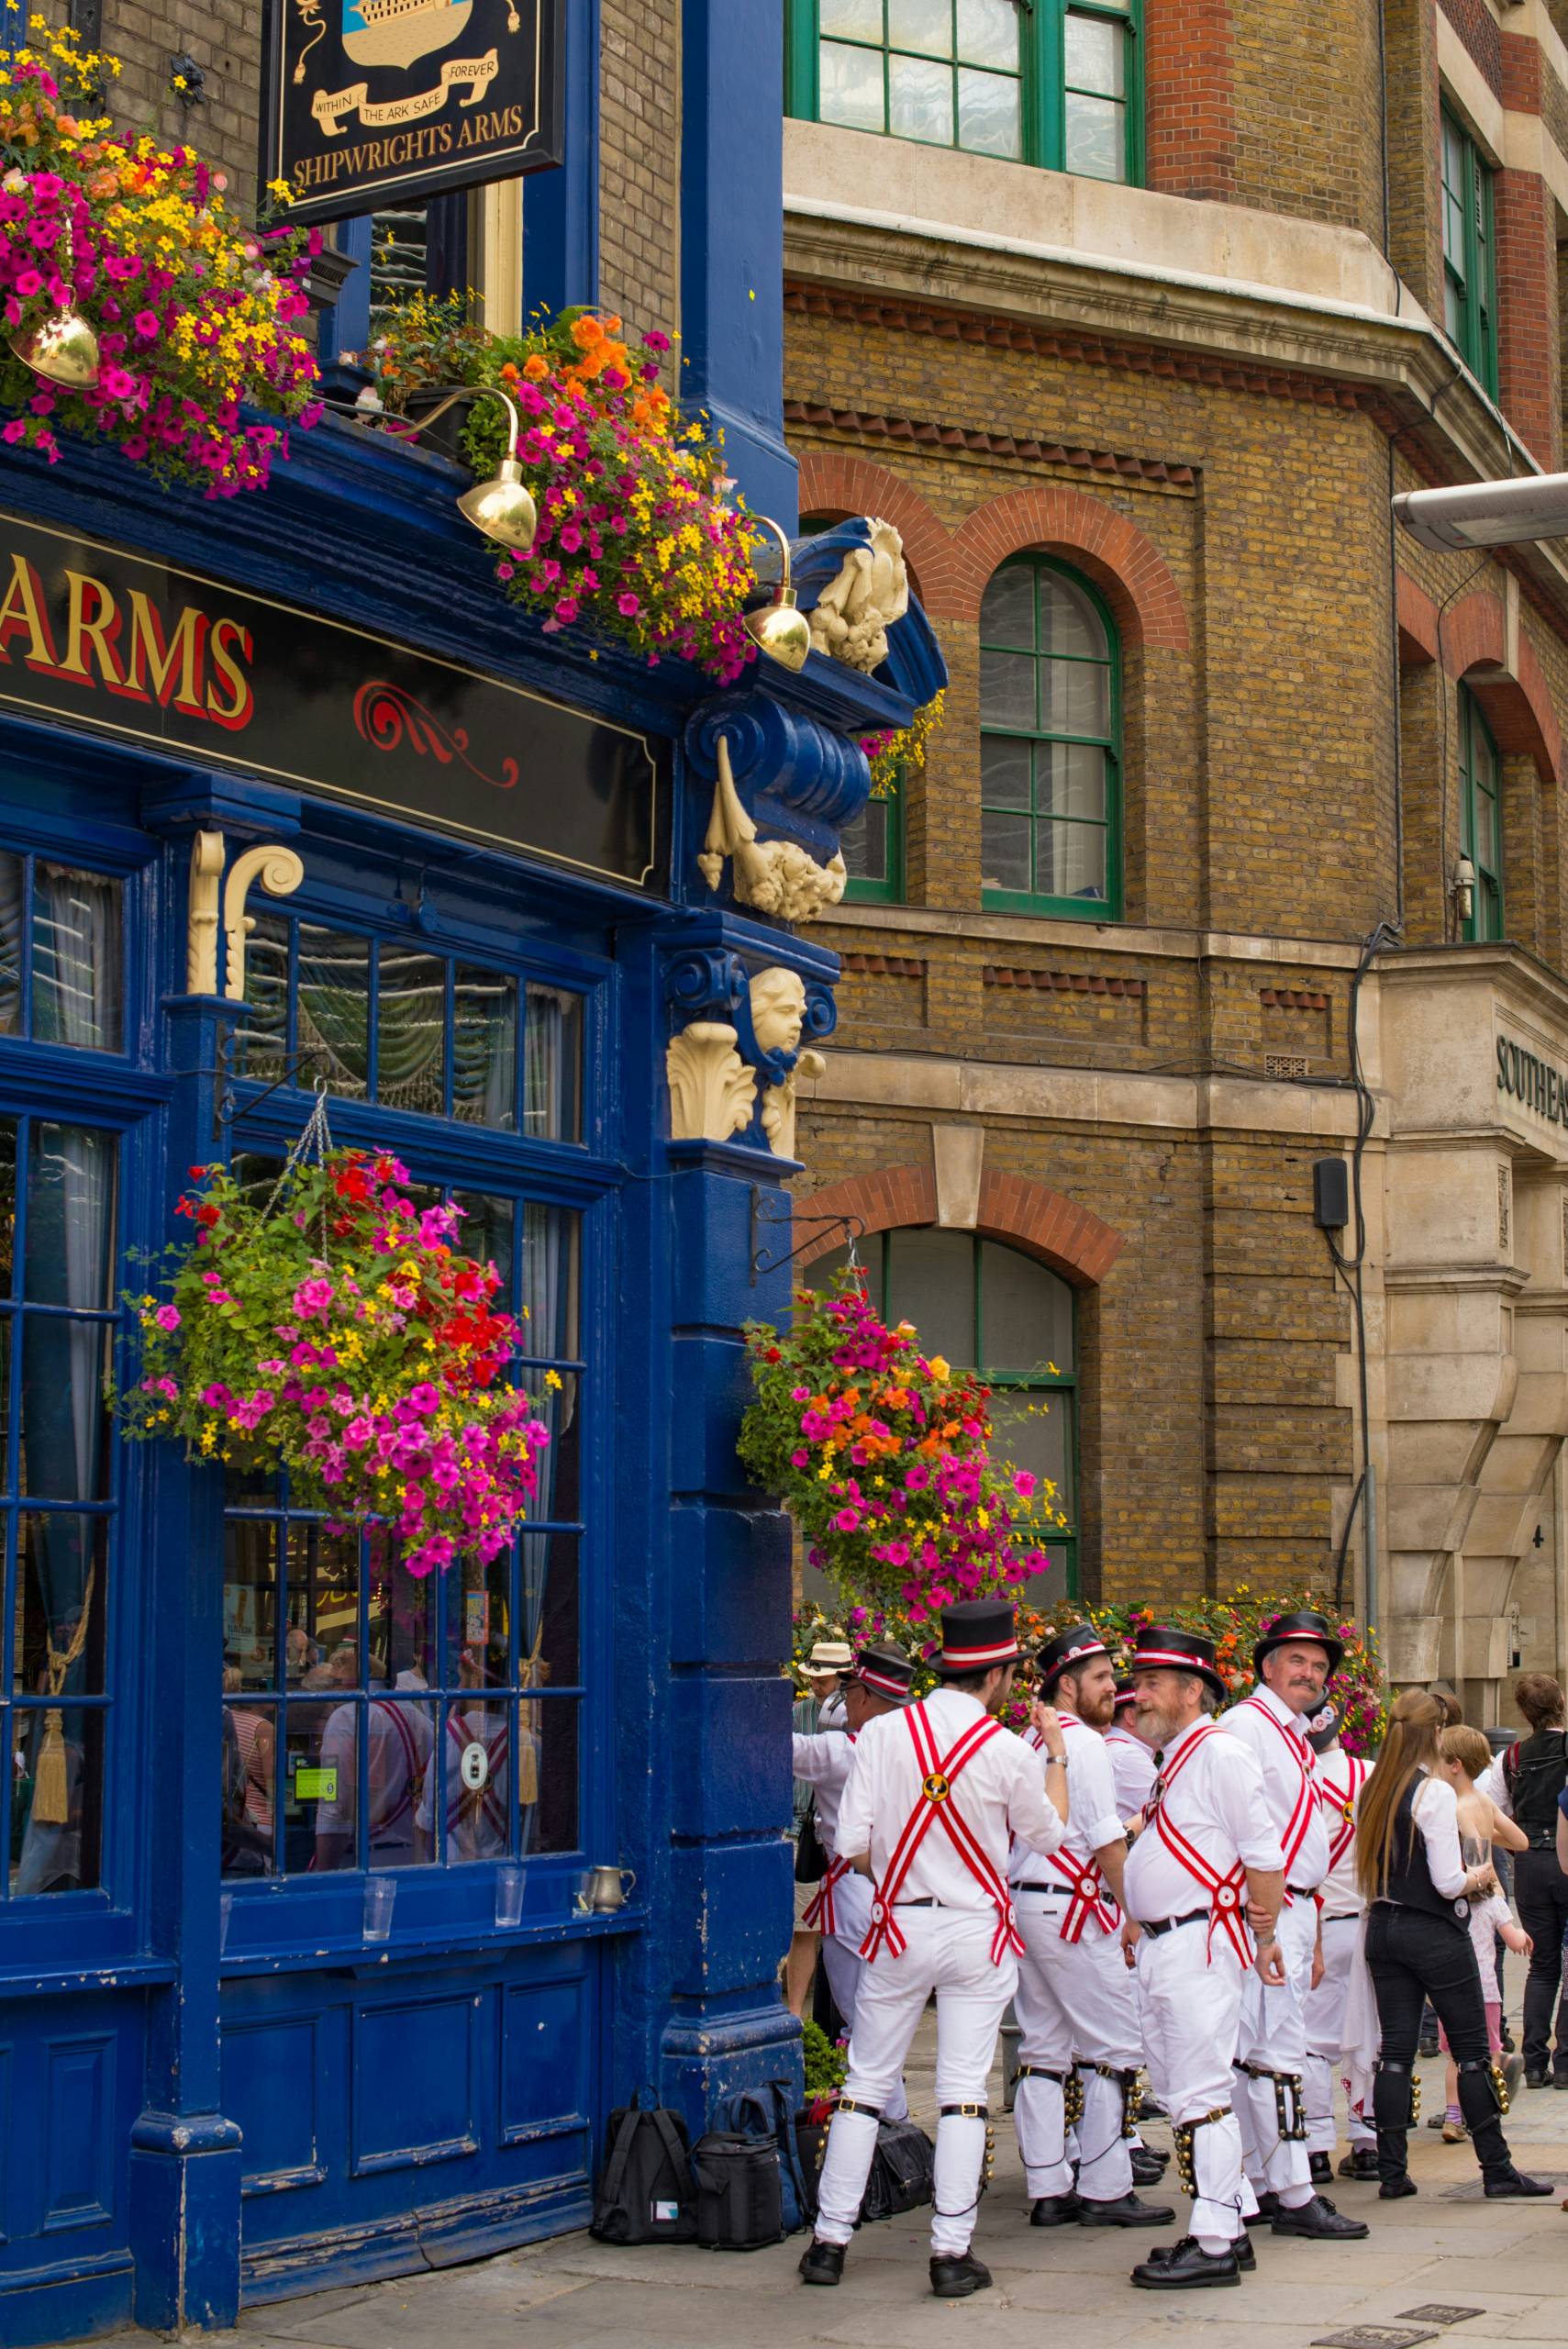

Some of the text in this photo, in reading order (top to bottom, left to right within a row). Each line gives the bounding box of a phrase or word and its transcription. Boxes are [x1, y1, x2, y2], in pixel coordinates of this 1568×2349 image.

[316, 61, 495, 121] WITHIN THE ARK SAFE FOREVER
[294, 105, 523, 187] SHIPWRIGHTS ARMS
[0, 552, 253, 731] ARMS
